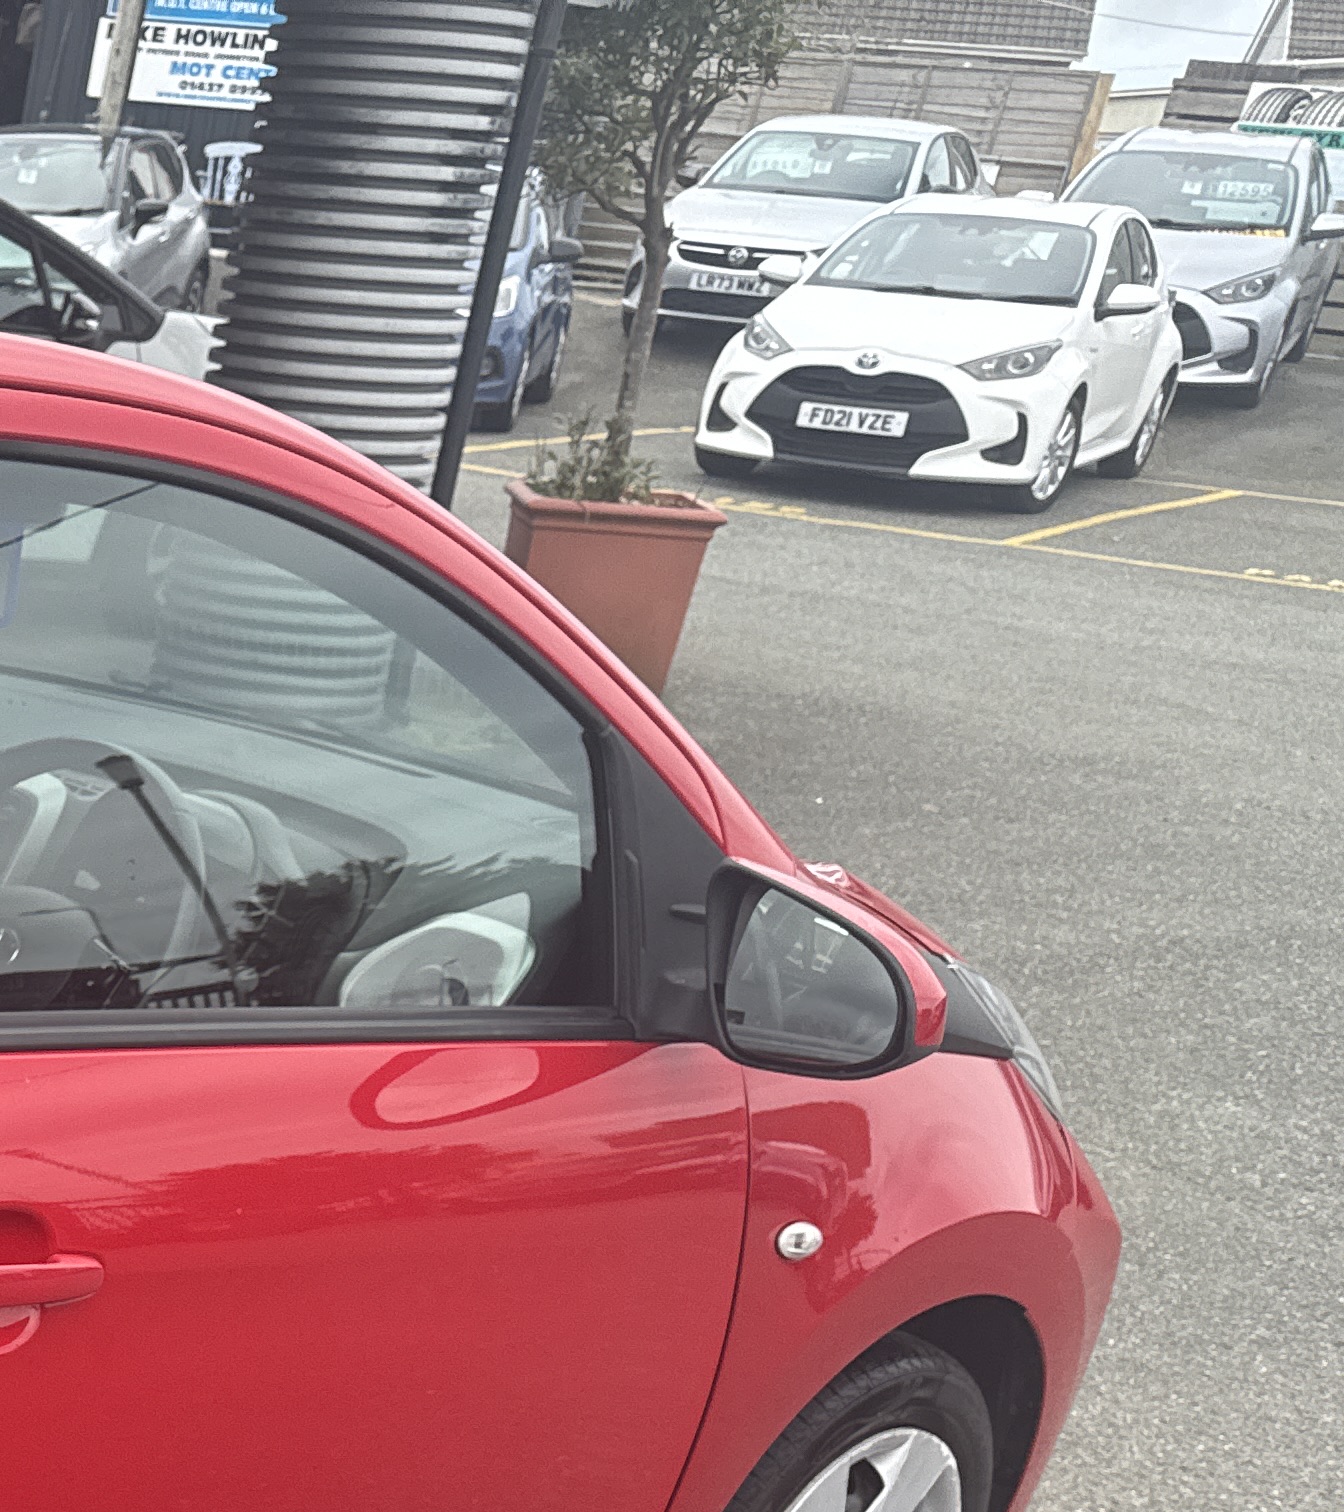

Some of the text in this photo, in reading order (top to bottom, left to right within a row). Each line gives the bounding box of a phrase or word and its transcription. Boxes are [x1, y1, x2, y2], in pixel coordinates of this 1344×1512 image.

[169, 60, 215, 78] MOT
[808, 407, 896, 432] FD21 VZE
